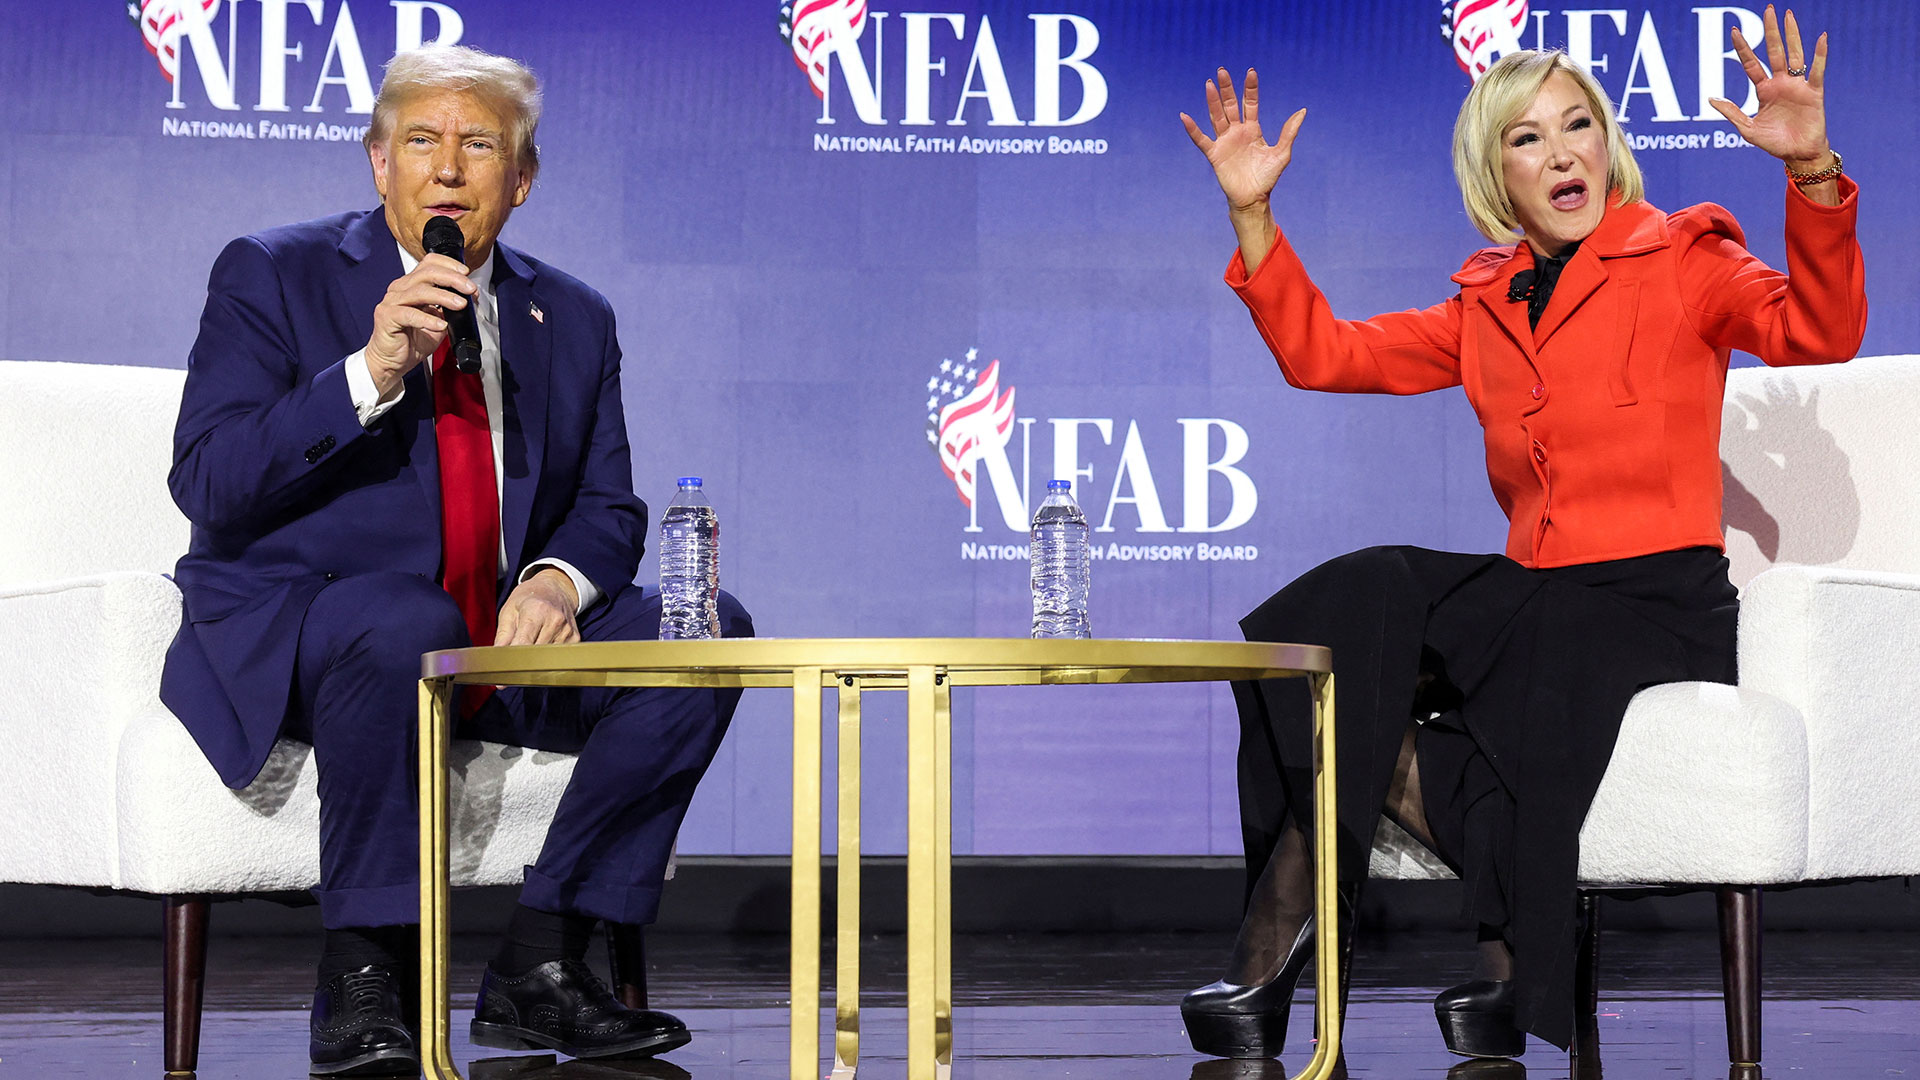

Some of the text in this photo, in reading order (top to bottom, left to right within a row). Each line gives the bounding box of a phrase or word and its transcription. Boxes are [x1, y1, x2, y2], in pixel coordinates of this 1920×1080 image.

[816, 12, 1109, 126] NFAB
[162, 116, 257, 139] NATIONAL
[259, 119, 312, 140] FAITH
[813, 133, 1108, 154] NATIONAL FAITH ADVISORY BOARD
[1624, 132, 1711, 150] ADVISORY
[963, 417, 1258, 533] NFAB
[961, 541, 1031, 561] NATION
[1106, 542, 1195, 561] ADVISORY
[1196, 542, 1259, 561] BOARD
